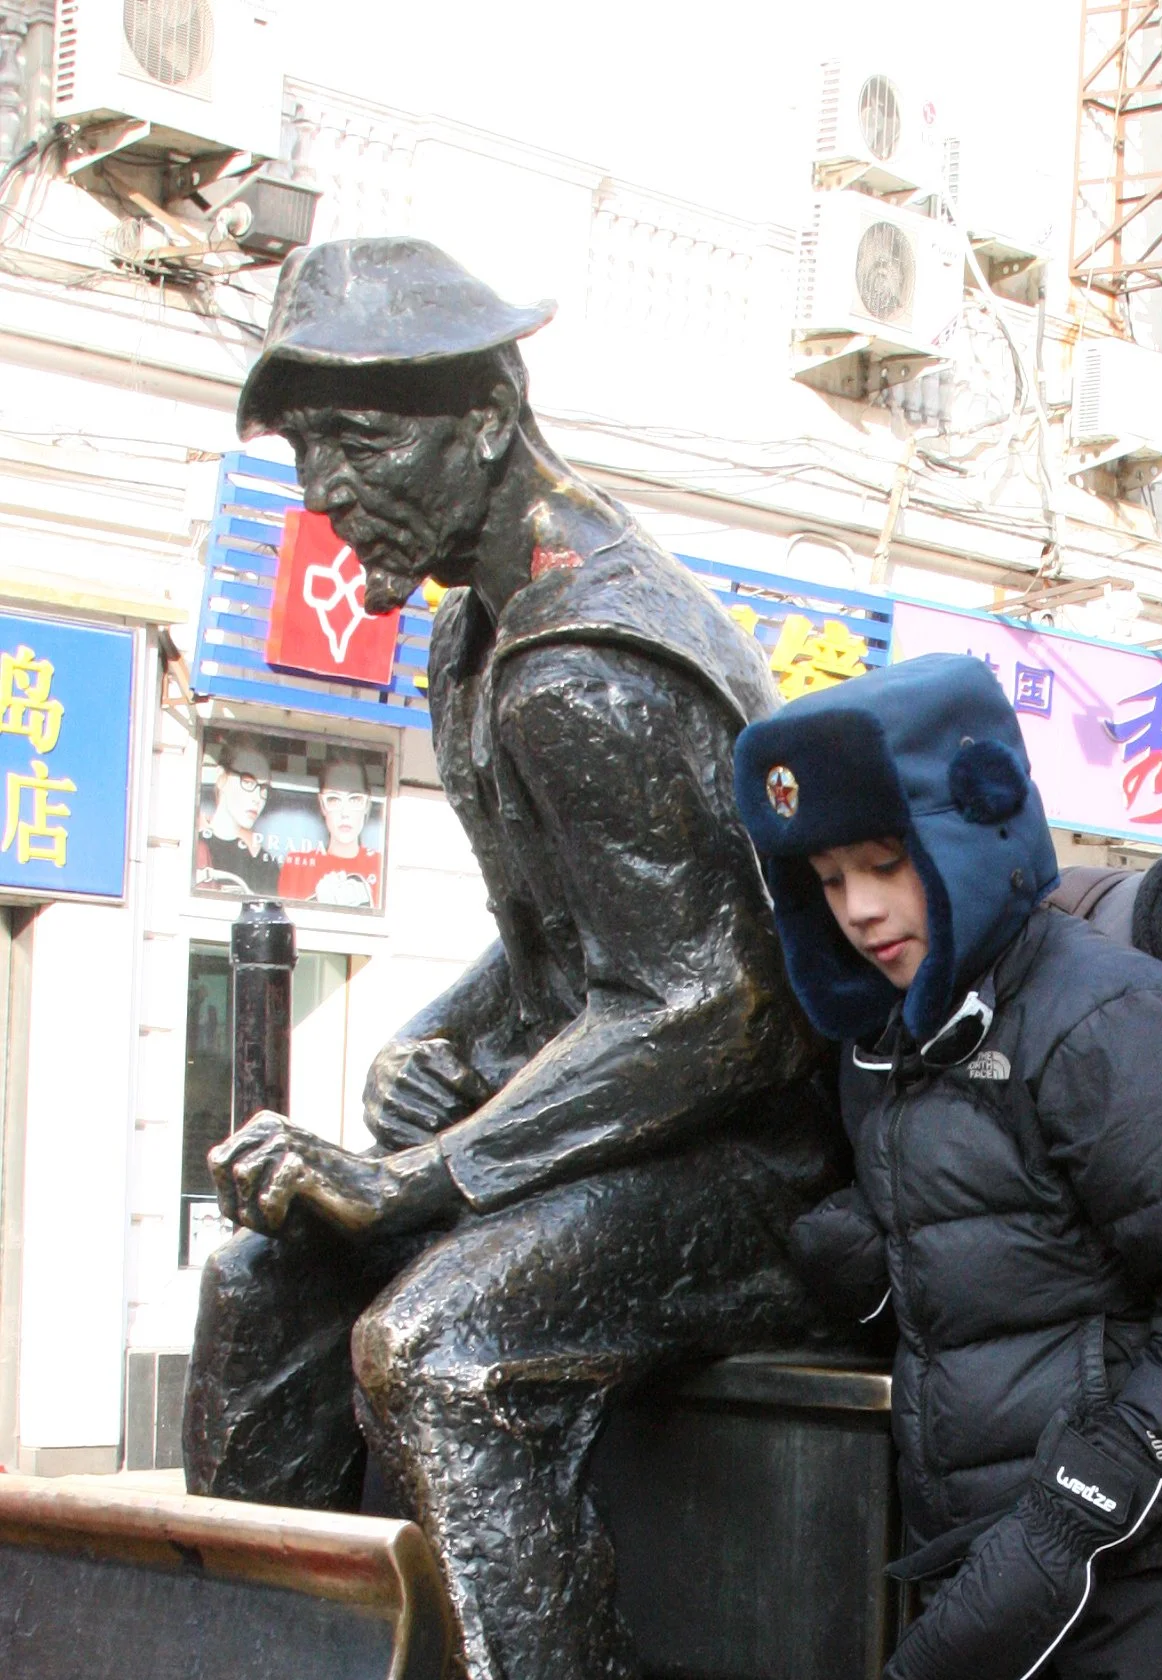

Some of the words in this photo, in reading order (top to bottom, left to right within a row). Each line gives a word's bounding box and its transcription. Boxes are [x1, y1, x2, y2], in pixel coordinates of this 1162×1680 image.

[0, 645, 64, 753] 岛
[1, 760, 77, 868] 店
[252, 832, 328, 856] PRADA
[263, 852, 317, 867] EYEWEAR
[977, 1050, 993, 1061] THE
[969, 1069, 994, 1079] FACE
